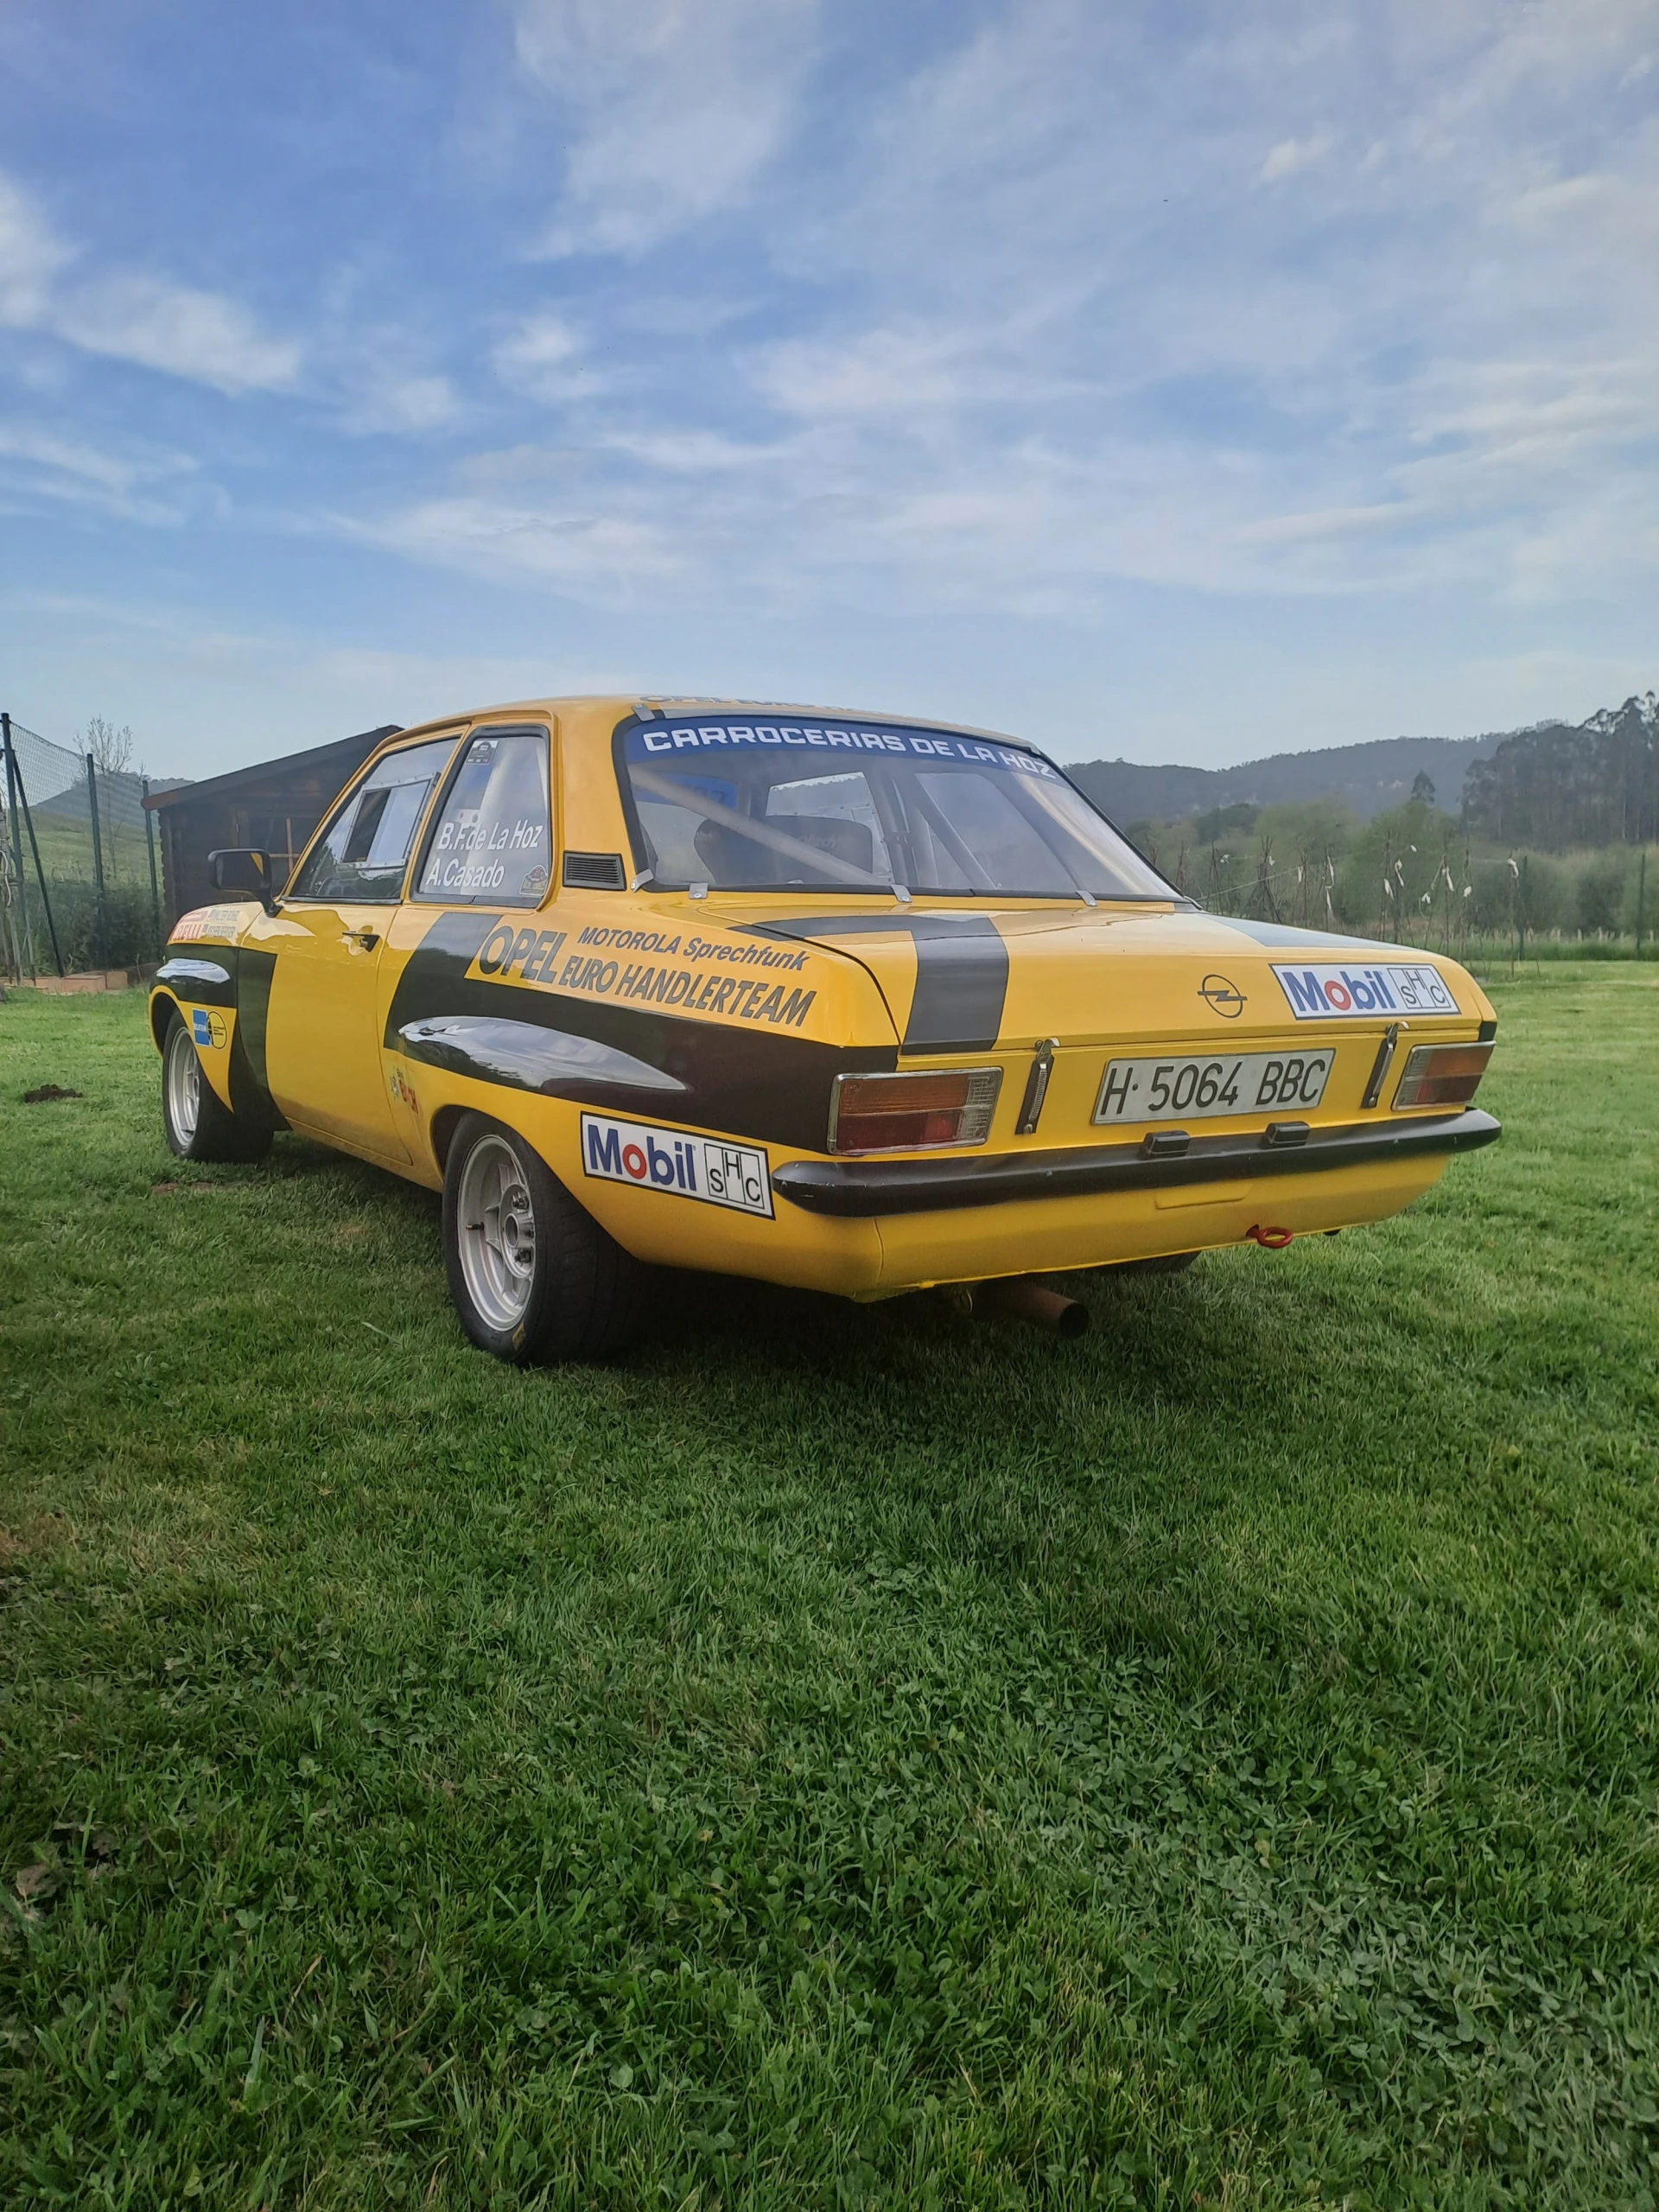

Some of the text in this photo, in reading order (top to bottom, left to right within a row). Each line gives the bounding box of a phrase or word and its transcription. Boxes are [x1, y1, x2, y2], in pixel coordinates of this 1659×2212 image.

[642, 725, 1057, 779] CARROCERIAS DE LA HOZ
[486, 821, 511, 851] La
[508, 818, 544, 849] Hoz
[425, 857, 505, 889] A.Casado
[479, 925, 568, 984] OPEL
[577, 926, 811, 971] MOTOROLA Sprechfunk
[558, 955, 817, 1027] EURO HANDLERTEAM
[1281, 969, 1397, 1012] Mobil
[1147, 1061, 1241, 1112] 5064
[1255, 1058, 1326, 1106] BBC
[588, 1124, 697, 1192] Mobil
